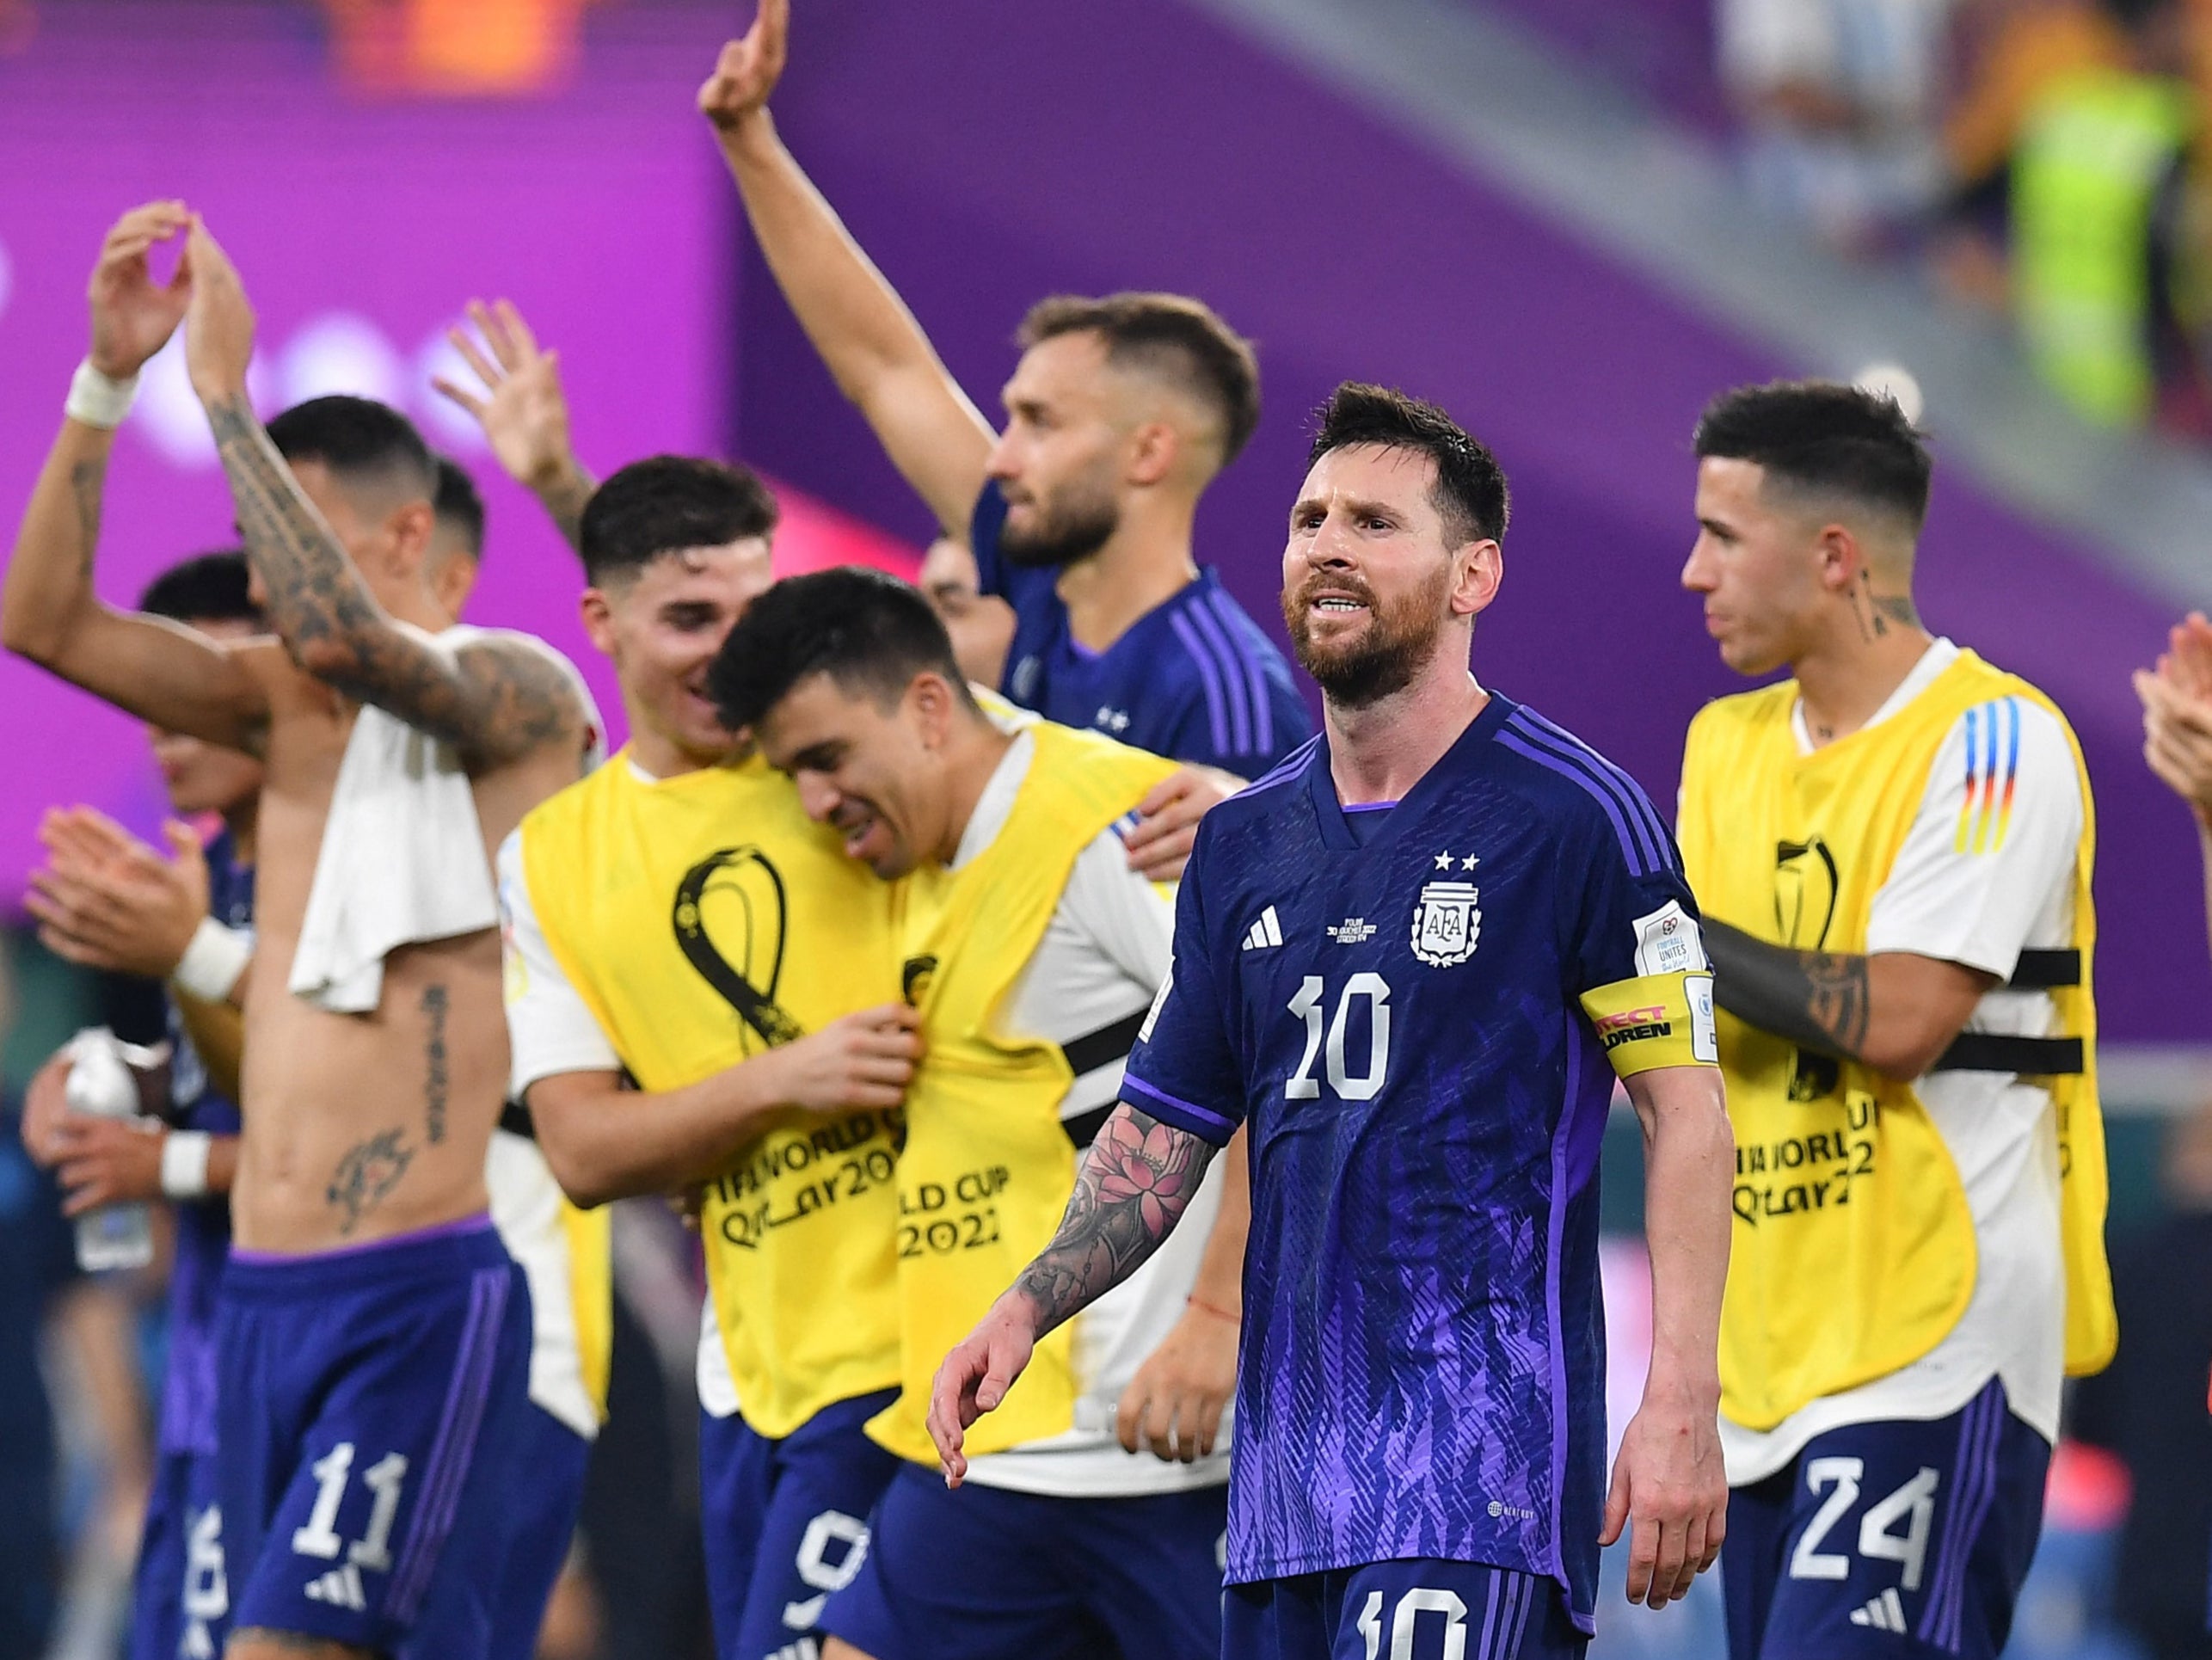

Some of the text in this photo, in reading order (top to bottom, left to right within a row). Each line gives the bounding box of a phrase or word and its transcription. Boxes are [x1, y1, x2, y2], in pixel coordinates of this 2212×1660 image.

[1426, 904, 1462, 942] AFA
[1659, 944, 1687, 962] UNITES
[1285, 972, 1391, 1099] 10
[956, 1165, 1009, 1202] CUP
[291, 1442, 409, 1571] 11
[1789, 1457, 1939, 1590] 24
[1357, 1589, 1467, 1660] 10
